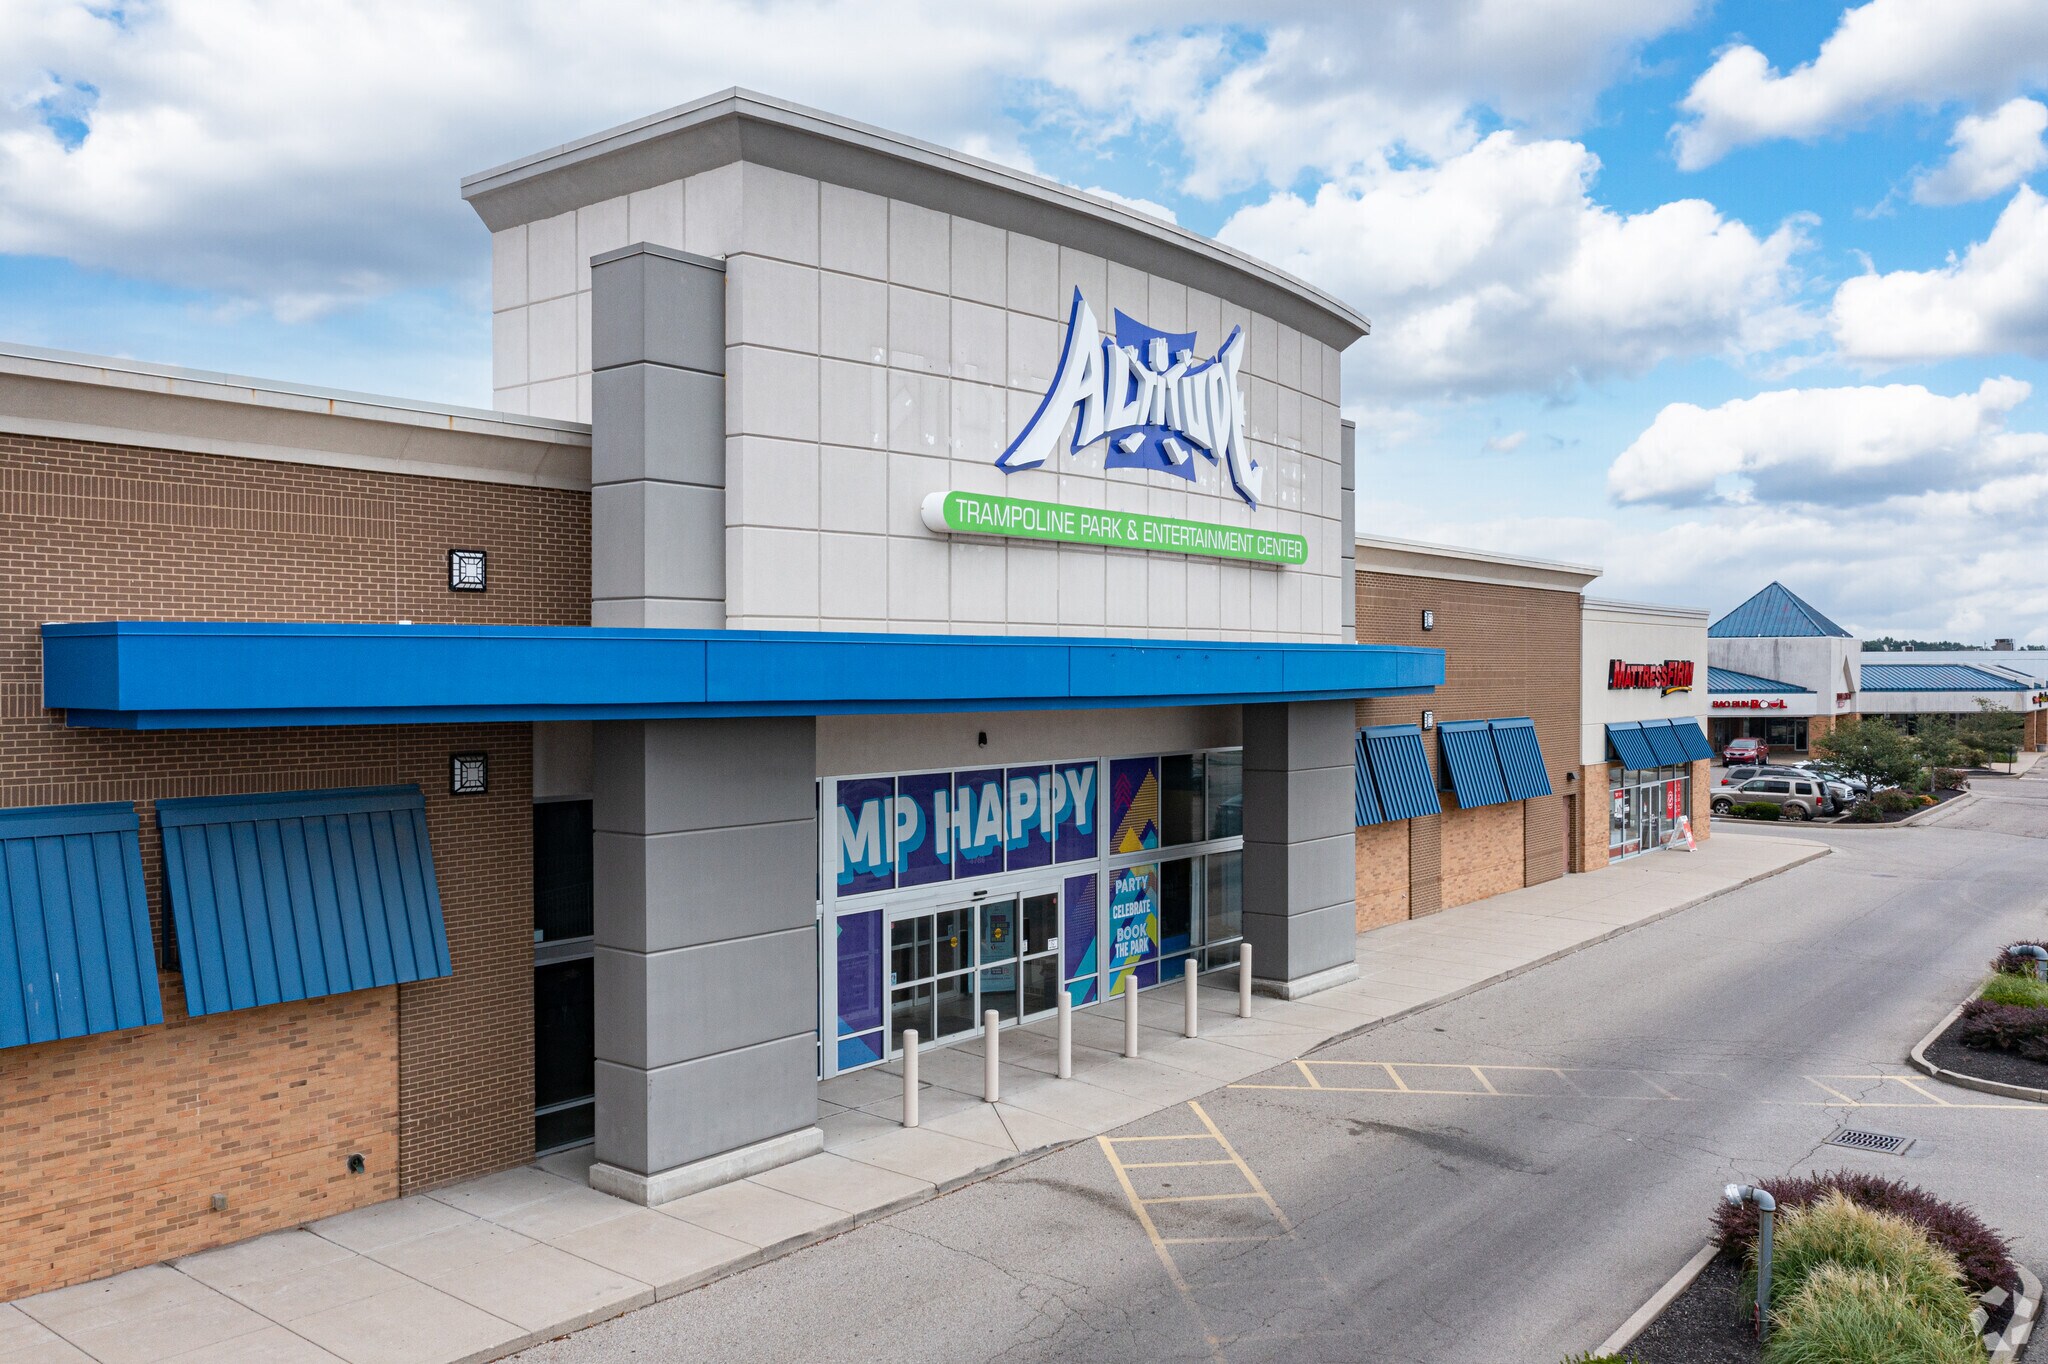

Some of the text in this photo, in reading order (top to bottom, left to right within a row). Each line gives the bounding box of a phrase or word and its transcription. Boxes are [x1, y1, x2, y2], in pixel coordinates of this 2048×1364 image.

[955, 499, 1302, 559] TRAMPOLINE PARK & ENTERTAINMENT CENTER
[934, 766, 1096, 861] HAPPY
[1115, 875, 1149, 894] PARTY
[1113, 899, 1151, 919] CELEBRATE
[1116, 922, 1147, 942] BOOK
[1115, 937, 1149, 958] THE PARK
